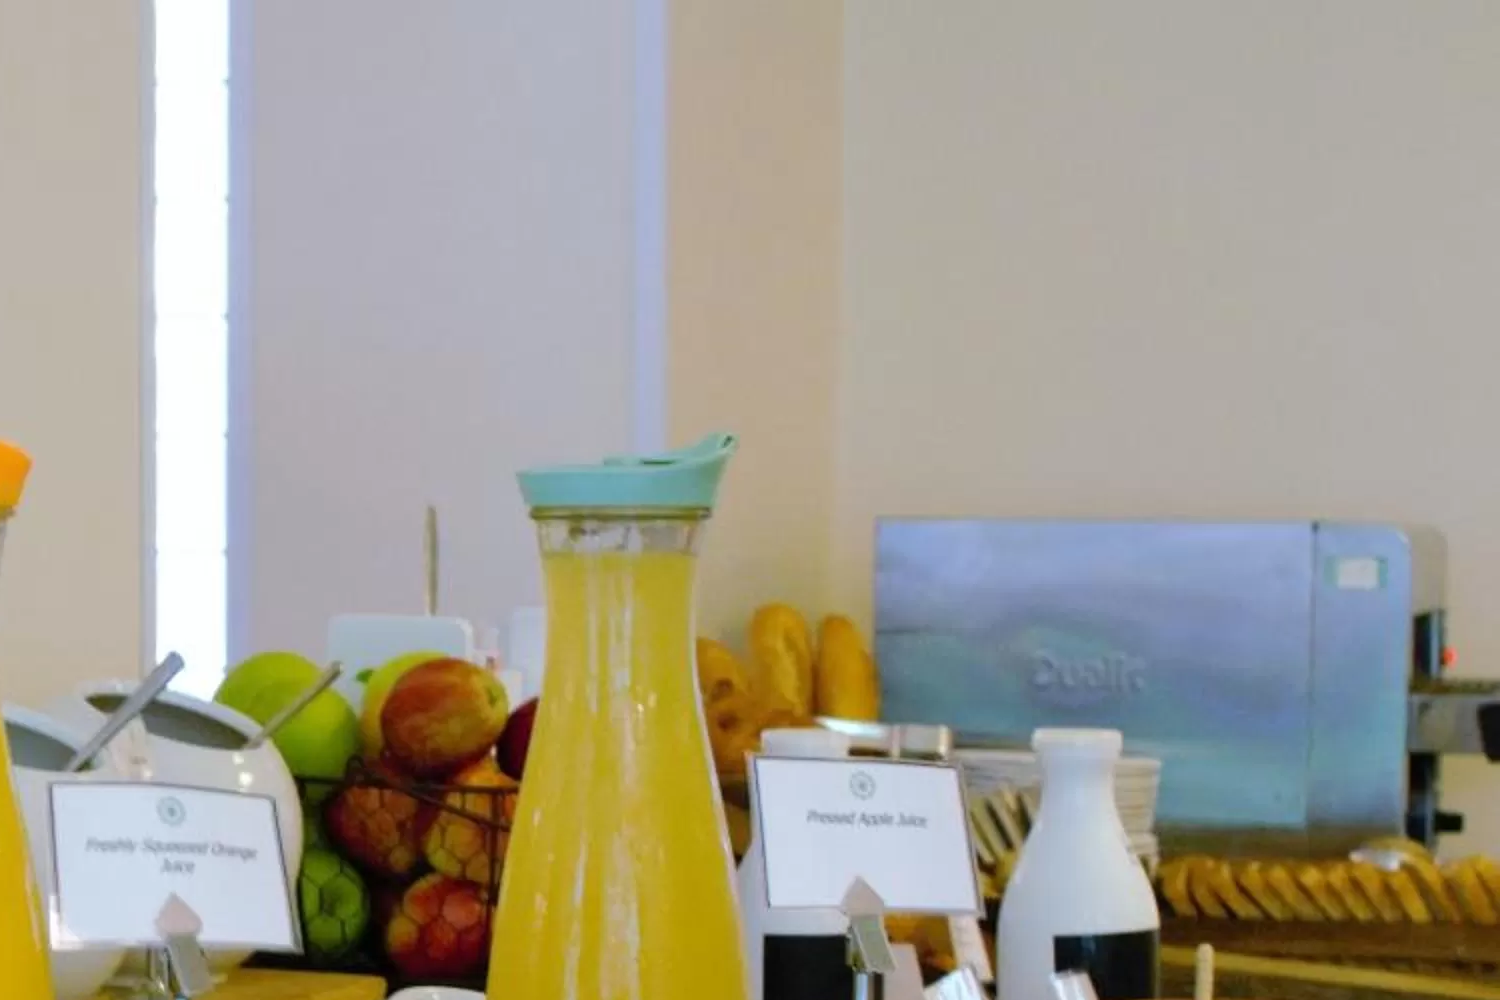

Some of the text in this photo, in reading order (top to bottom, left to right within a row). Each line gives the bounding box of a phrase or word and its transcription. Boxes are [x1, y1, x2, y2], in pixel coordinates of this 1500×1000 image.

[806, 810, 928, 831] Pressed Apple Juice
[85, 836, 135, 855] Freshly
[211, 842, 258, 862] Orange
[161, 858, 196, 876] Juice
